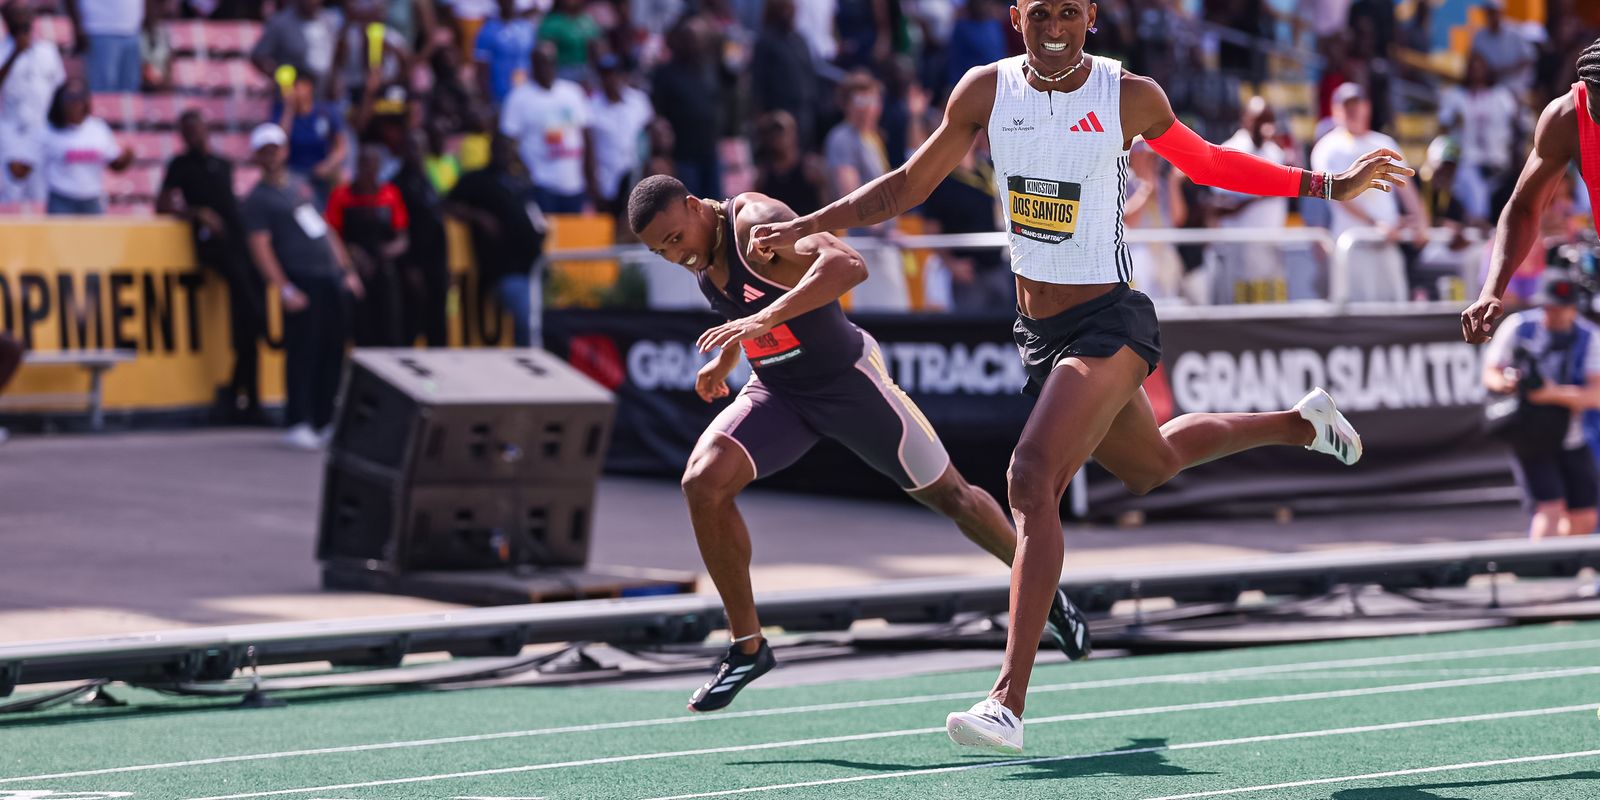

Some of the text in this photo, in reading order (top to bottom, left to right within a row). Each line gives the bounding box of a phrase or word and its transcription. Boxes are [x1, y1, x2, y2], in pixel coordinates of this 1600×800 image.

[1026, 180, 1057, 195] KINGSTON
[1013, 195, 1073, 223] DOS SANTOS
[894, 342, 1028, 394] TRACK
[1171, 349, 1325, 413] GRAND
[1326, 345, 1430, 412] SLAM
